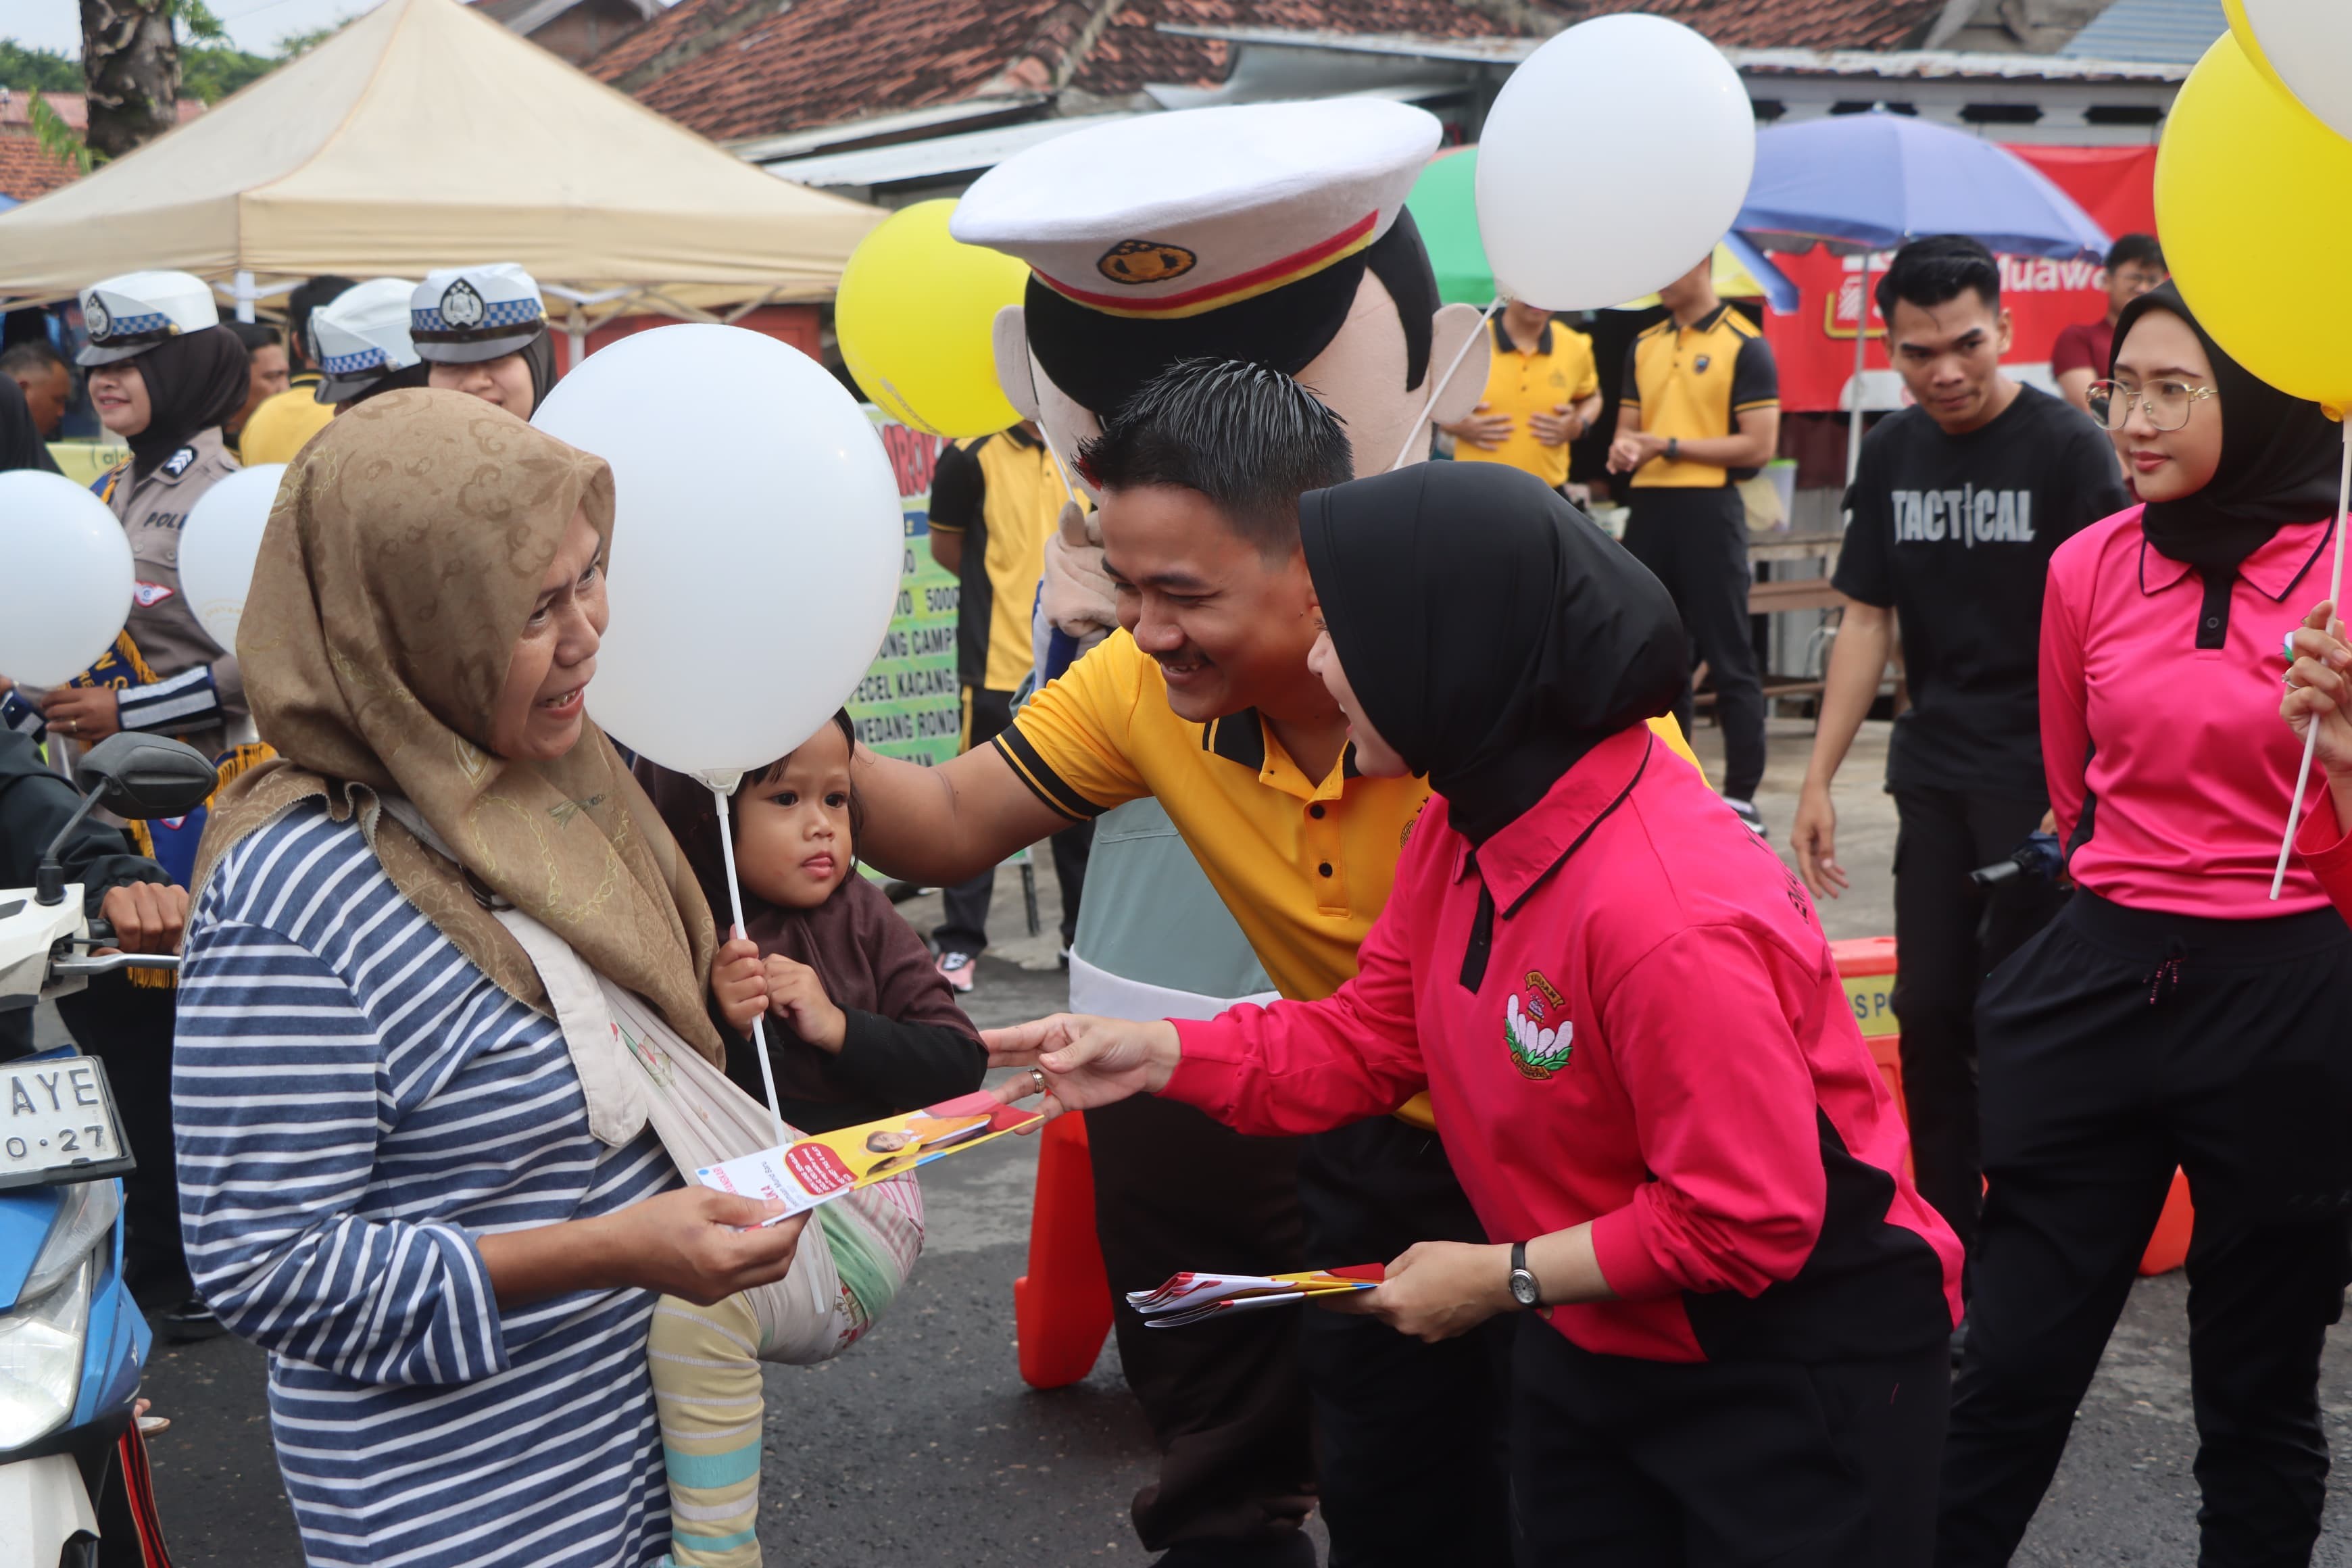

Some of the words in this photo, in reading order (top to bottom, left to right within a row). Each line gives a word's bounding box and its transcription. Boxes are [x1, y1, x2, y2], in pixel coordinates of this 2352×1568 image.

[143, 512, 189, 531] POLI
[1891, 483, 2036, 549] TACTICAL
[912, 627, 957, 655] CAMP
[850, 675, 893, 704] ECEL
[917, 710, 959, 738] ROND
[11, 1068, 99, 1115] AYE
